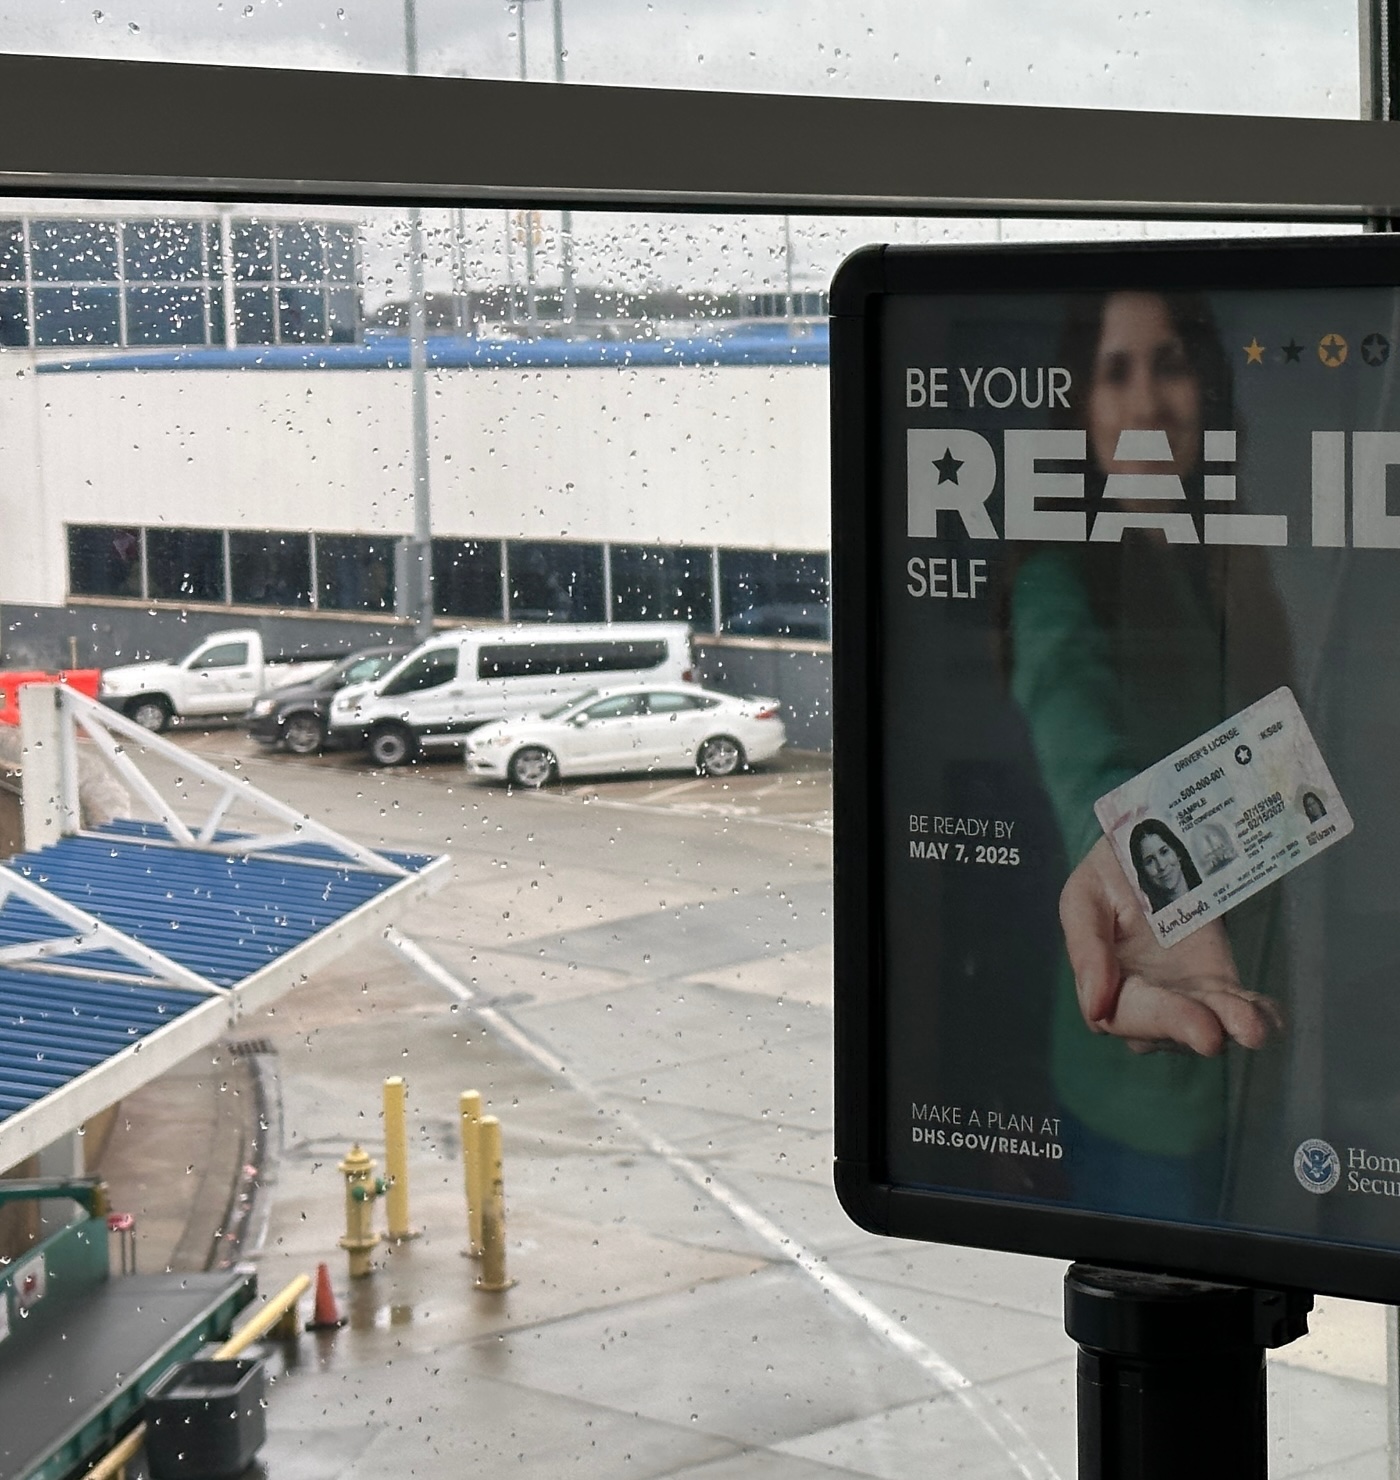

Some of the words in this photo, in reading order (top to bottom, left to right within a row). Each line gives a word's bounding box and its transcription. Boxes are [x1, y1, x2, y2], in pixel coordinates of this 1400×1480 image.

[906, 367, 948, 408] BE
[959, 367, 1073, 409] YOUR
[906, 428, 1288, 547] REAL
[906, 557, 988, 599] SELF
[1174, 746, 1210, 772] DRIVER'S
[1207, 726, 1241, 752] LICENSE
[909, 814, 929, 833] BE
[934, 816, 989, 837] READY
[995, 820, 1015, 840] BY
[909, 840, 949, 860] MAY
[954, 843, 969, 864] 7,
[975, 845, 1021, 866] 2025
[912, 1102, 962, 1125] MAKE
[968, 1109, 981, 1128] A
[988, 1111, 1033, 1133] PLAN
[1040, 1118, 1061, 1137] AT
[912, 1127, 1063, 1160] DHS.GOV/REAL-ID
